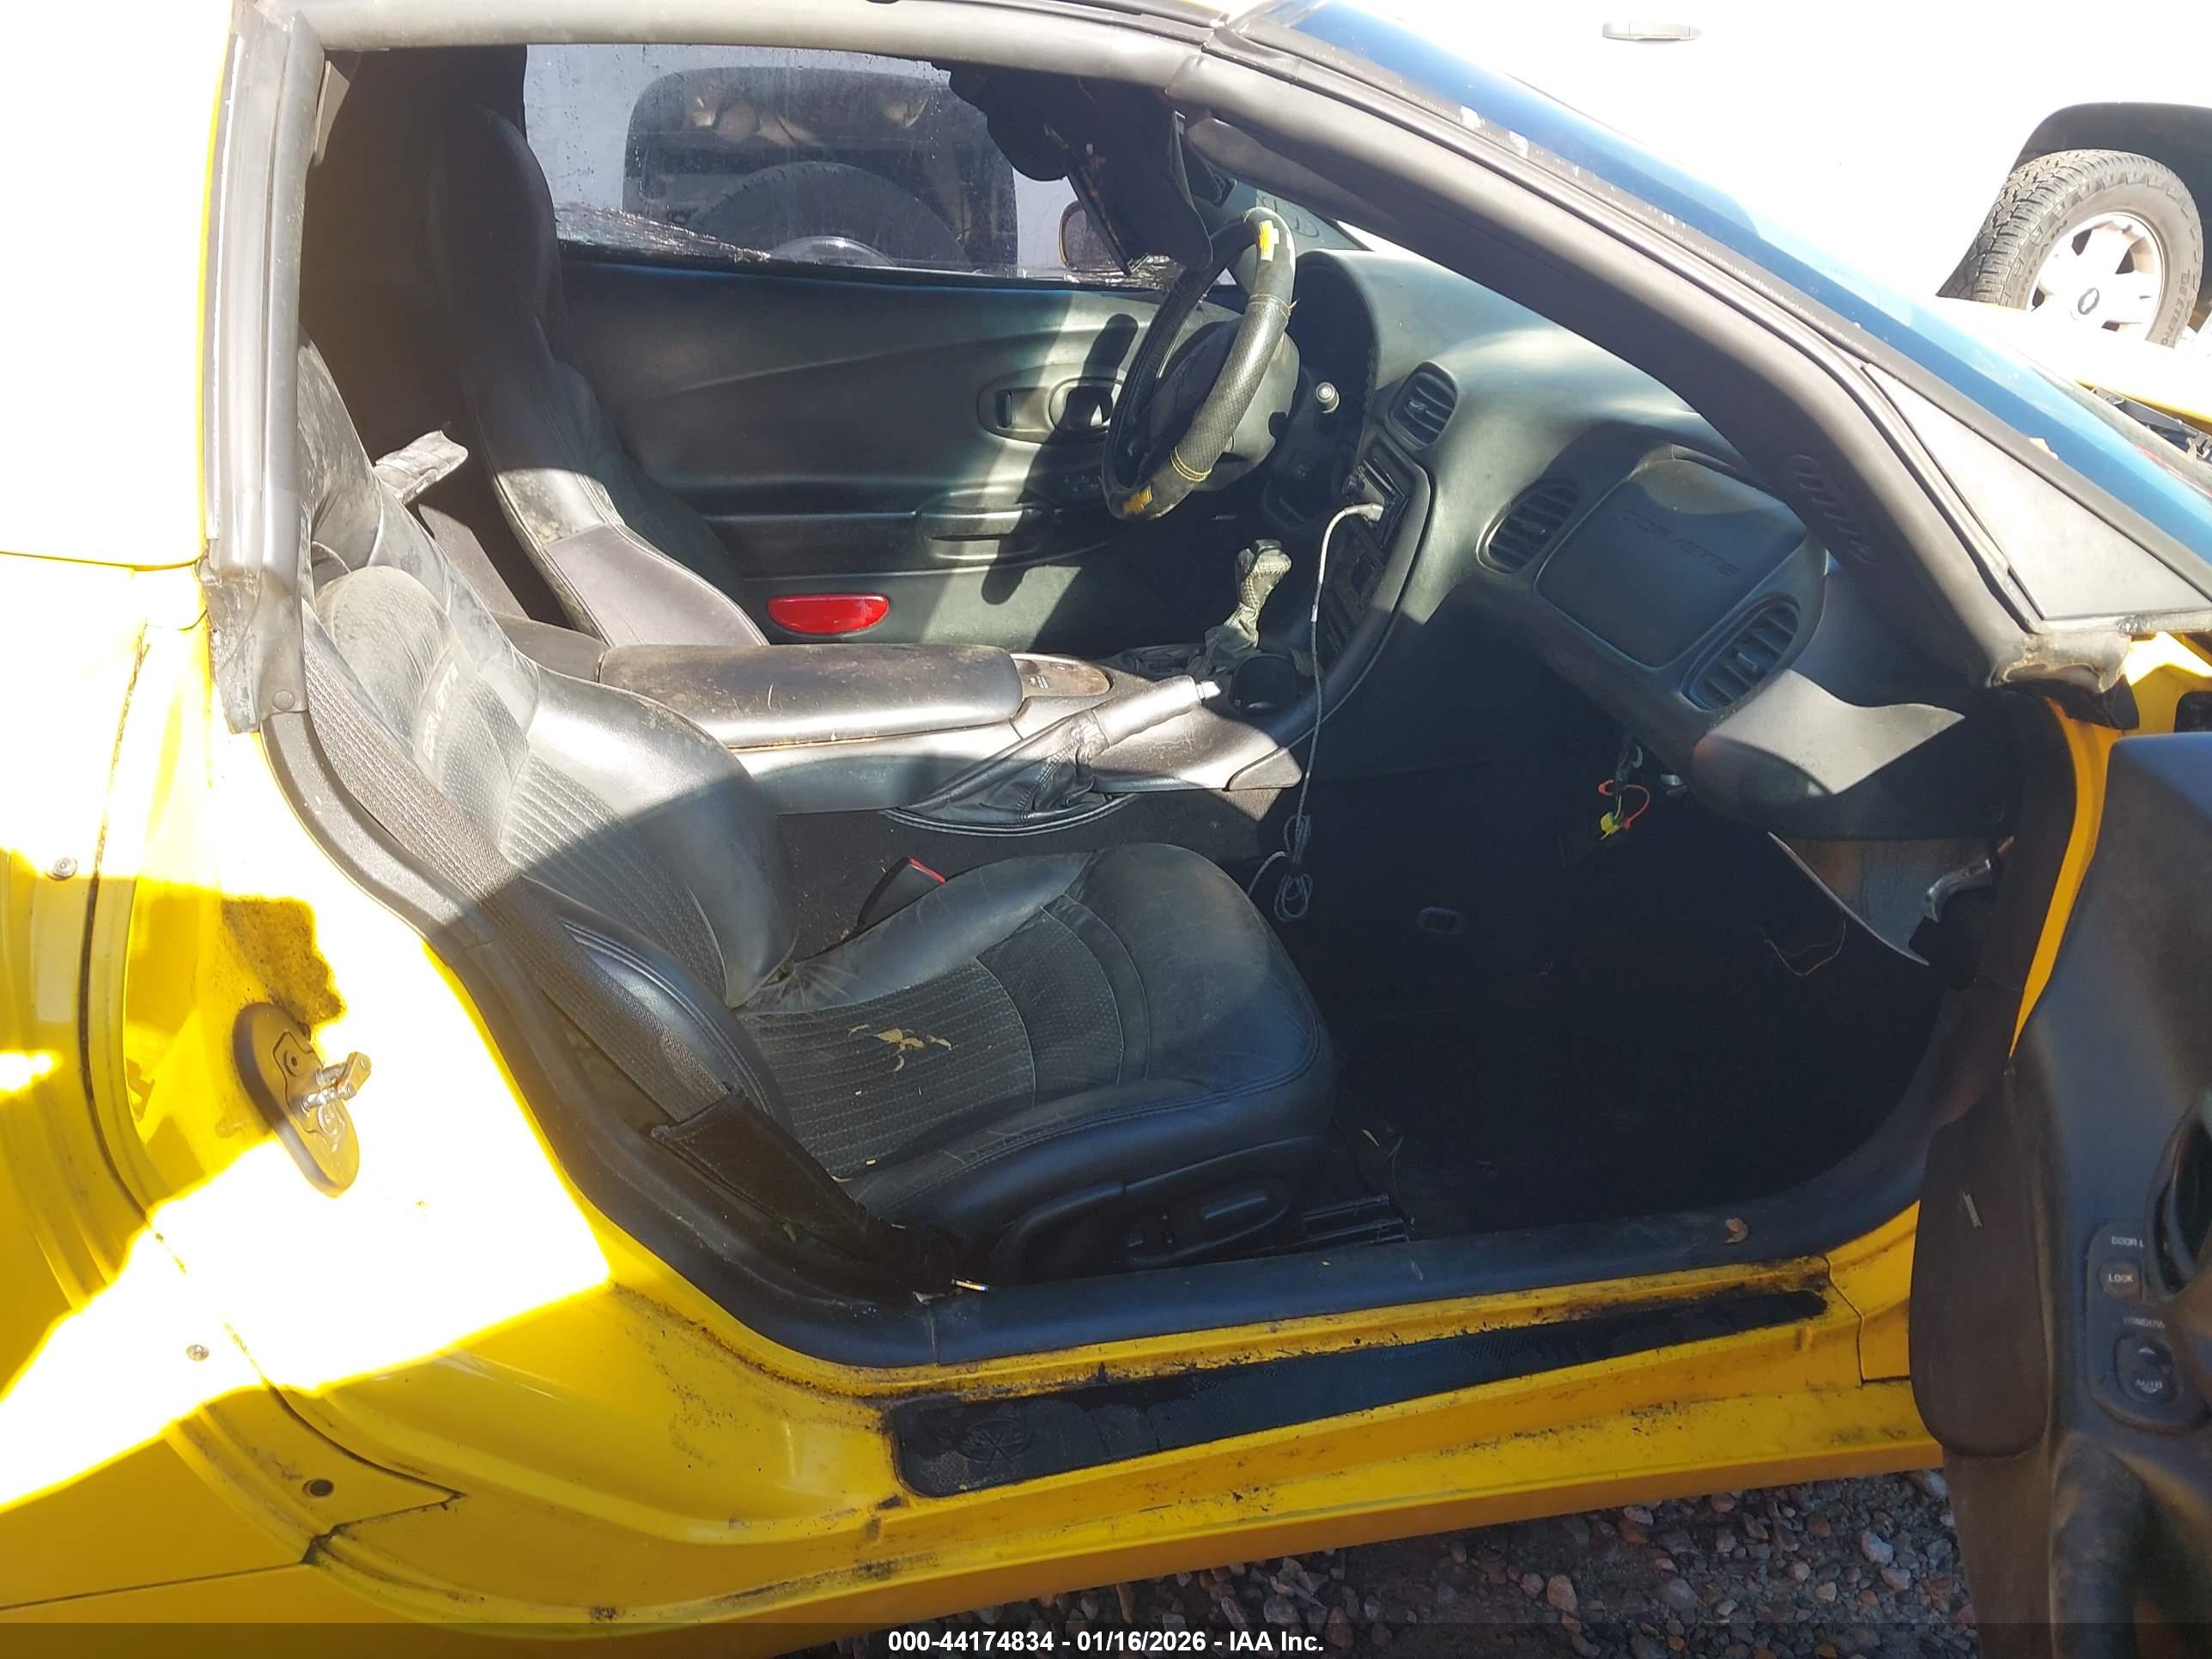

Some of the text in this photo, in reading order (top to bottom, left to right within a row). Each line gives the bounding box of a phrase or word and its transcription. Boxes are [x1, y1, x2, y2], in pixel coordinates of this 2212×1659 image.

[2111, 1236, 2137, 1246] DOOR
[2108, 1273, 2135, 1284] LOCK
[2123, 1316, 2166, 1329] WINDOW
[2134, 1378, 2164, 1389] AUTO
